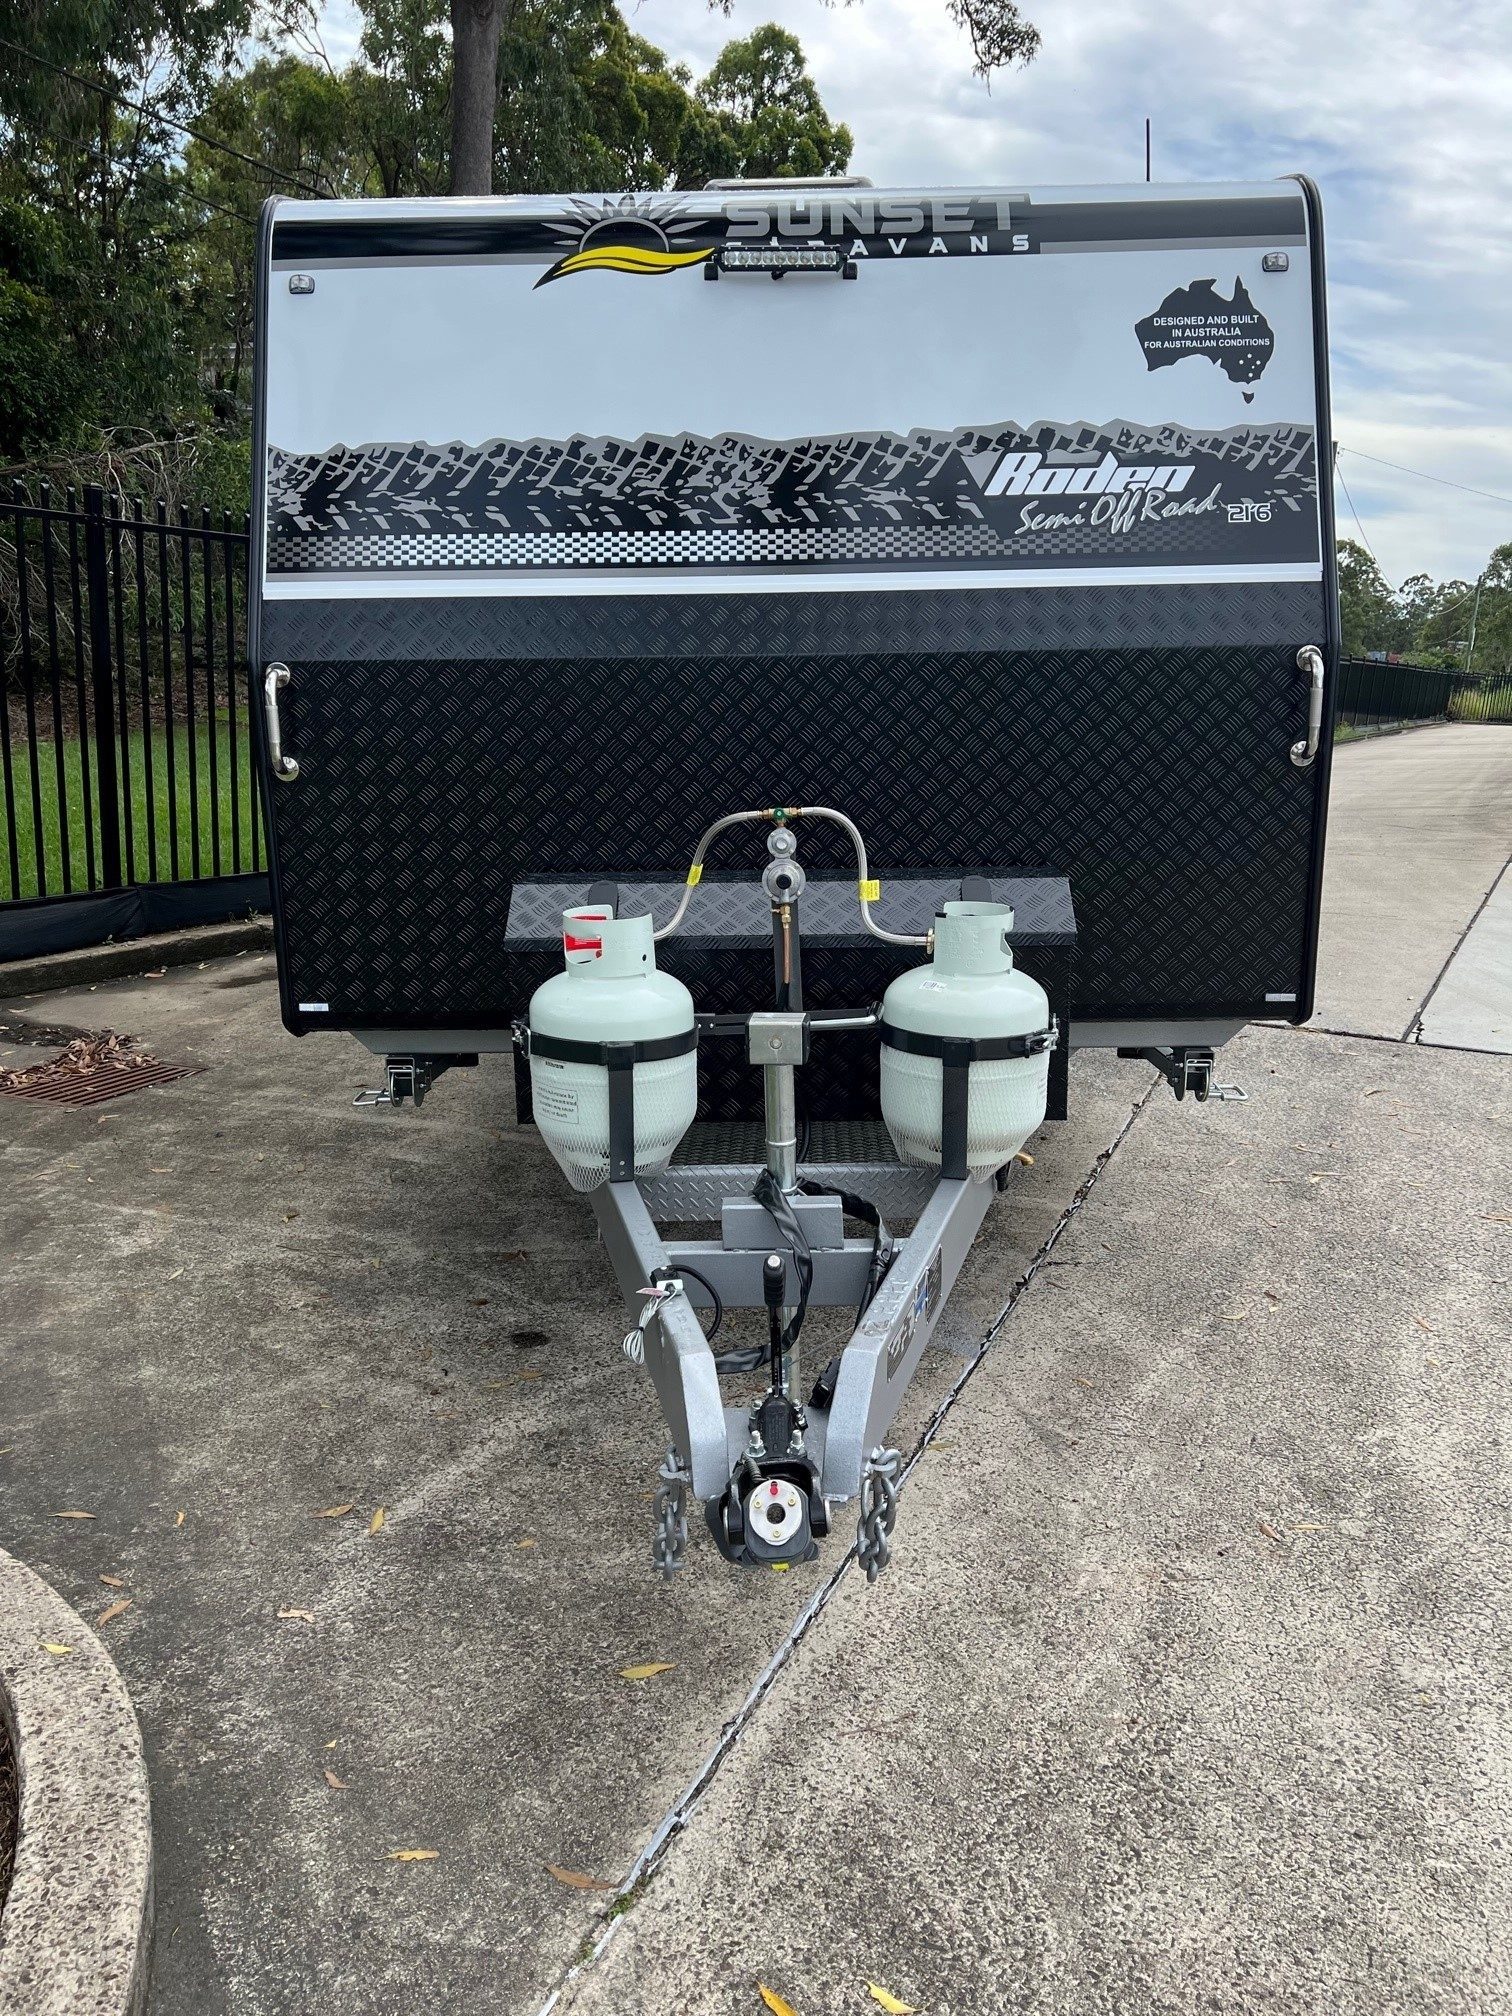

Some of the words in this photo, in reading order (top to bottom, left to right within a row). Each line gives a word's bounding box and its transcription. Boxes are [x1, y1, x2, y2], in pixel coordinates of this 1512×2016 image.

[724, 195, 1029, 237] SUNSET
[1153, 316, 1205, 326] DESIGNED
[1206, 315, 1229, 325] AND
[1230, 314, 1259, 324] BUILT
[1171, 328, 1182, 337] IN
[1184, 327, 1242, 337] AUSTRALIA
[1144, 341, 1162, 349] FOR
[1163, 339, 1217, 348] AUSTRALIAN
[1218, 338, 1270, 347] CONDITIONS
[984, 451, 1195, 496] Roden
[1014, 499, 1086, 535] Semi
[1090, 487, 1142, 534] Off
[1138, 482, 1222, 521] Road
